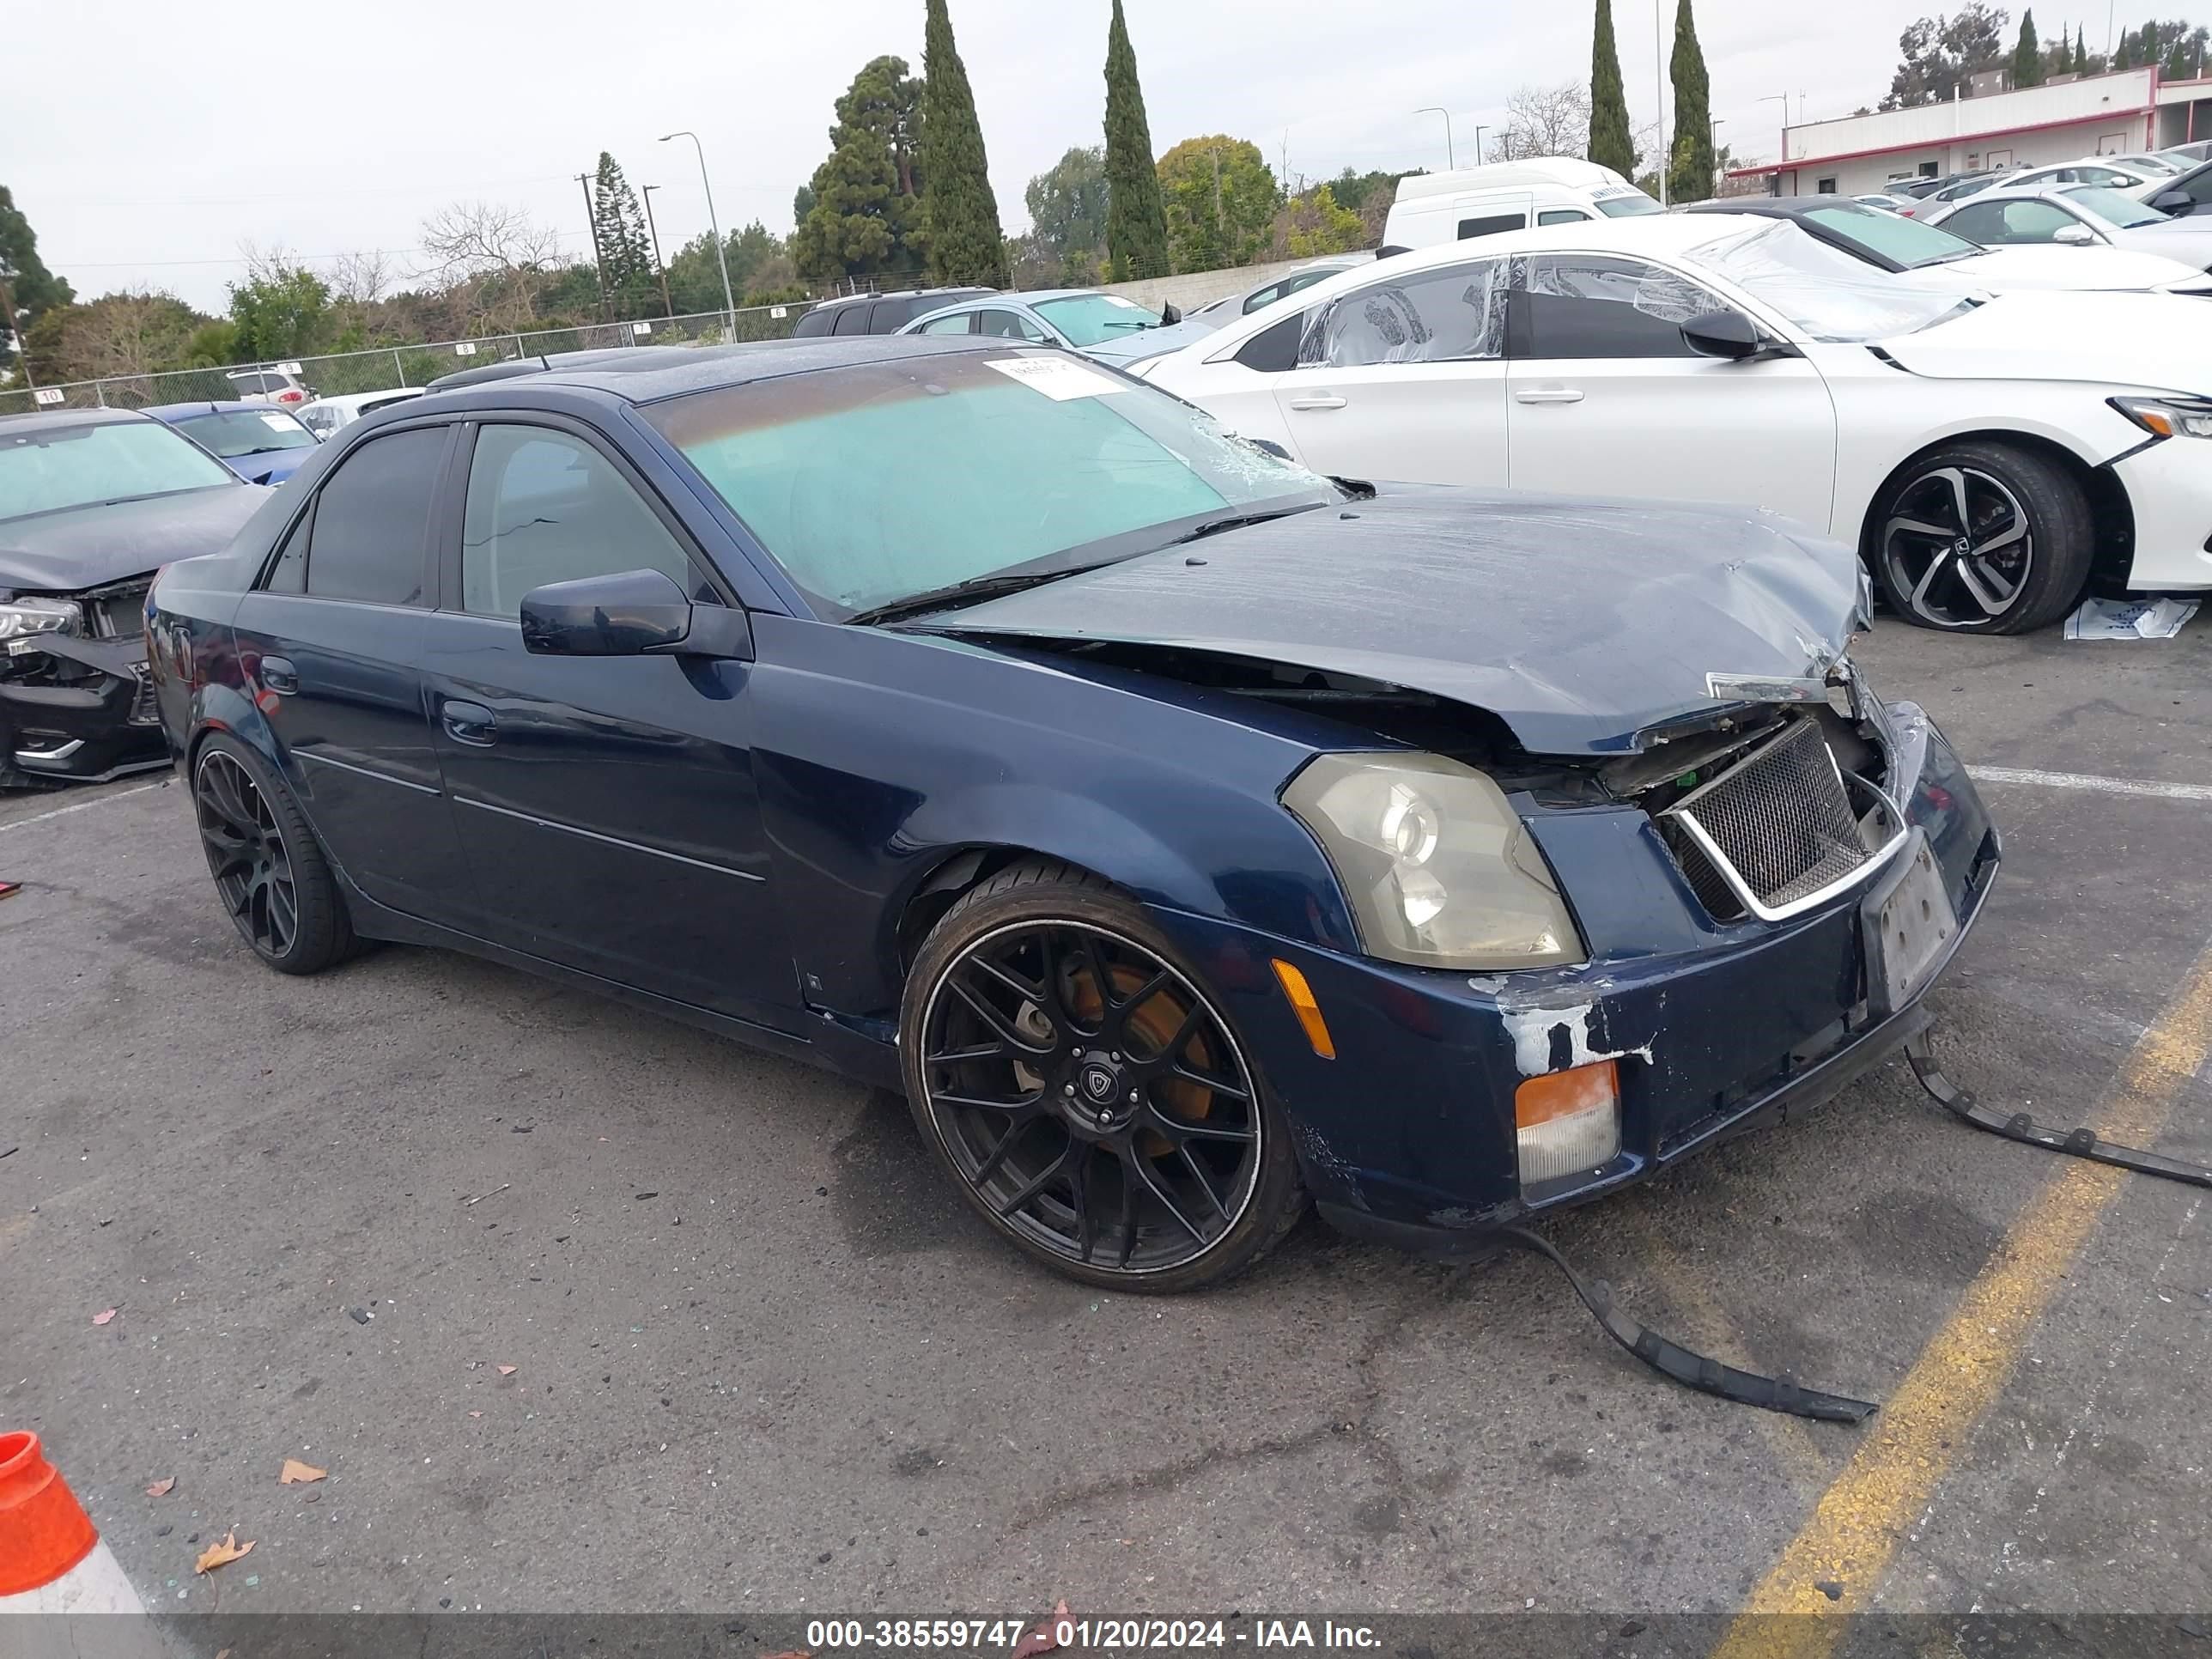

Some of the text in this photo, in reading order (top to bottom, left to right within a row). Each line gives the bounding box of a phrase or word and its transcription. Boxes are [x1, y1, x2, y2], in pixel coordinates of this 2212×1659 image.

[776, 308, 781, 317] 6
[463, 344, 469, 353] 8
[286, 363, 294, 373] 9
[43, 390, 58, 402] 10
